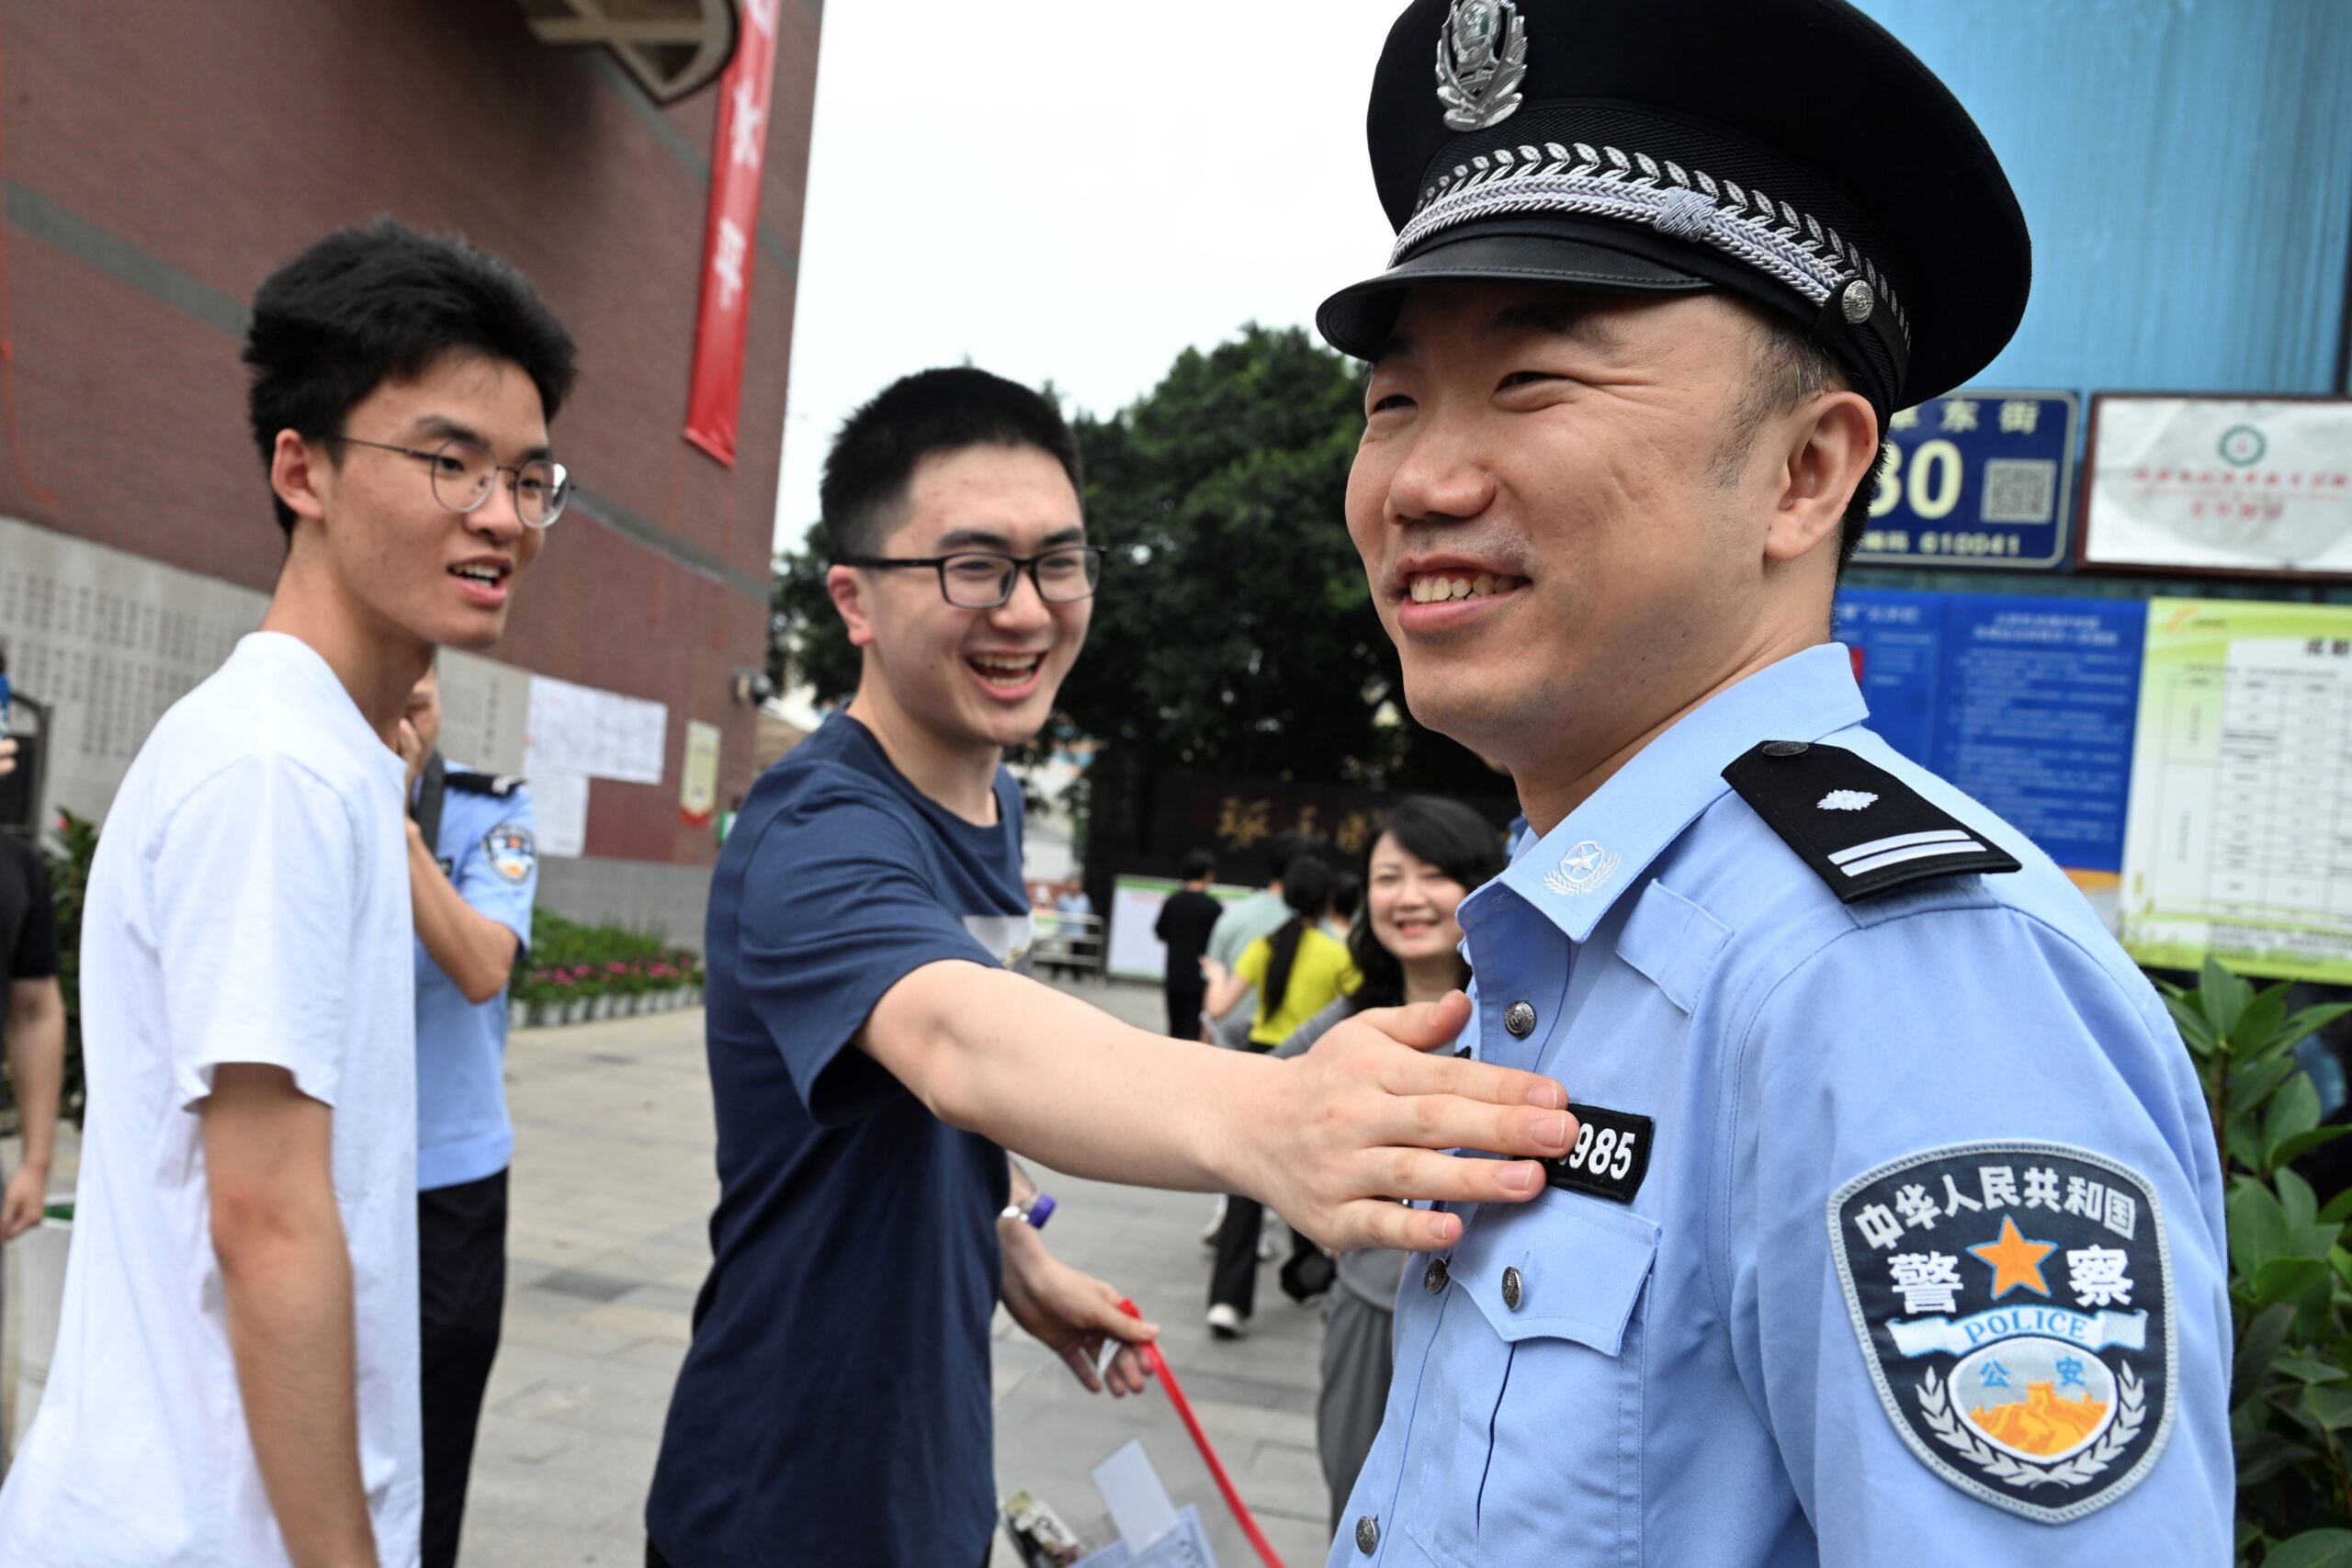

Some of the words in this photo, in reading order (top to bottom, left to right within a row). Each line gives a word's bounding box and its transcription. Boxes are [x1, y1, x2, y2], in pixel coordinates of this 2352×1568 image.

[1558, 1122, 1635, 1180] 985
[1854, 1165, 2136, 1251] 中华人民共和国
[1963, 1310, 2088, 1345] POLICE
